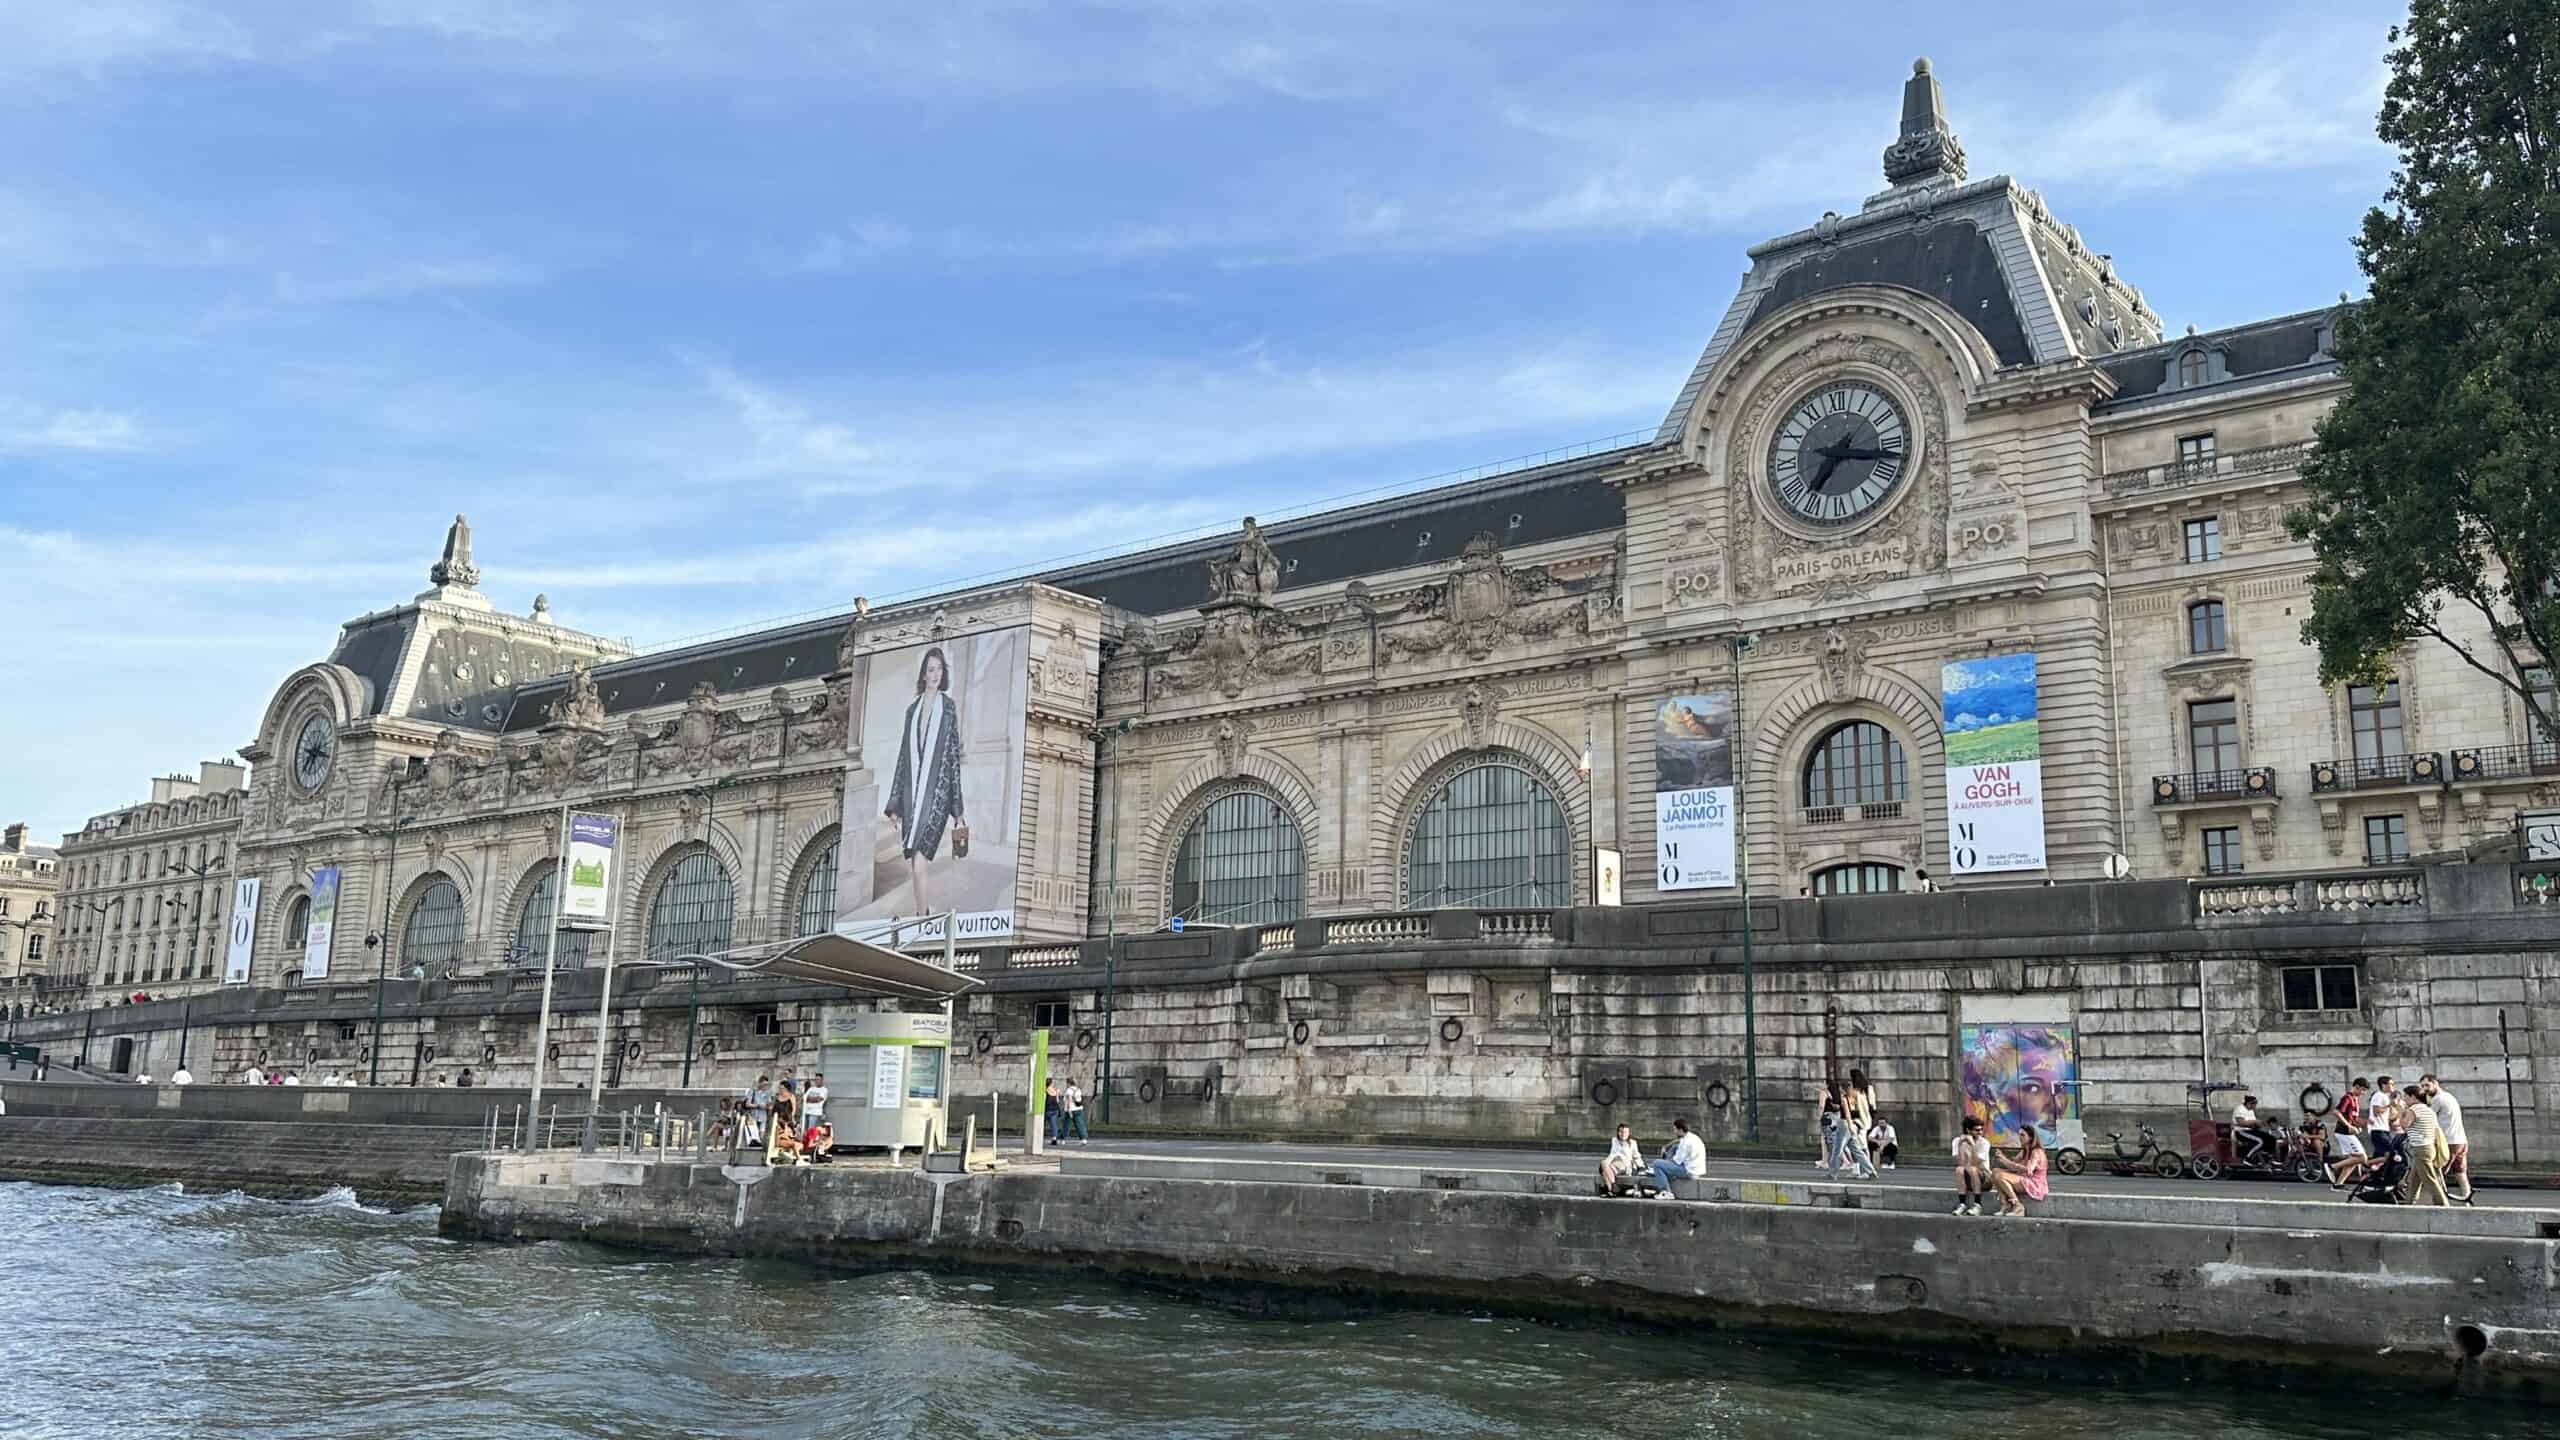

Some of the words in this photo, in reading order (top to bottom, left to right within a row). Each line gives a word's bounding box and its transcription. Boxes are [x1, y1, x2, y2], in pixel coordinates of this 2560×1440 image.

[1828, 391, 1846, 413] XII
[1801, 403, 1822, 425] XI
[1962, 524, 2005, 551] PO
[1777, 546, 1901, 579] PARIS-ORLEANS
[1675, 573, 1710, 596] PO
[1878, 618, 1939, 641] TOURS
[1973, 765, 2011, 783] VAN
[1671, 791, 1717, 808] LOUIS
[1965, 780, 2021, 801] GOGH
[1662, 805, 1728, 824] JANMOT
[1957, 822, 1974, 841] M
[1664, 842, 1678, 860] M
[957, 915, 1011, 934] VUITTON
